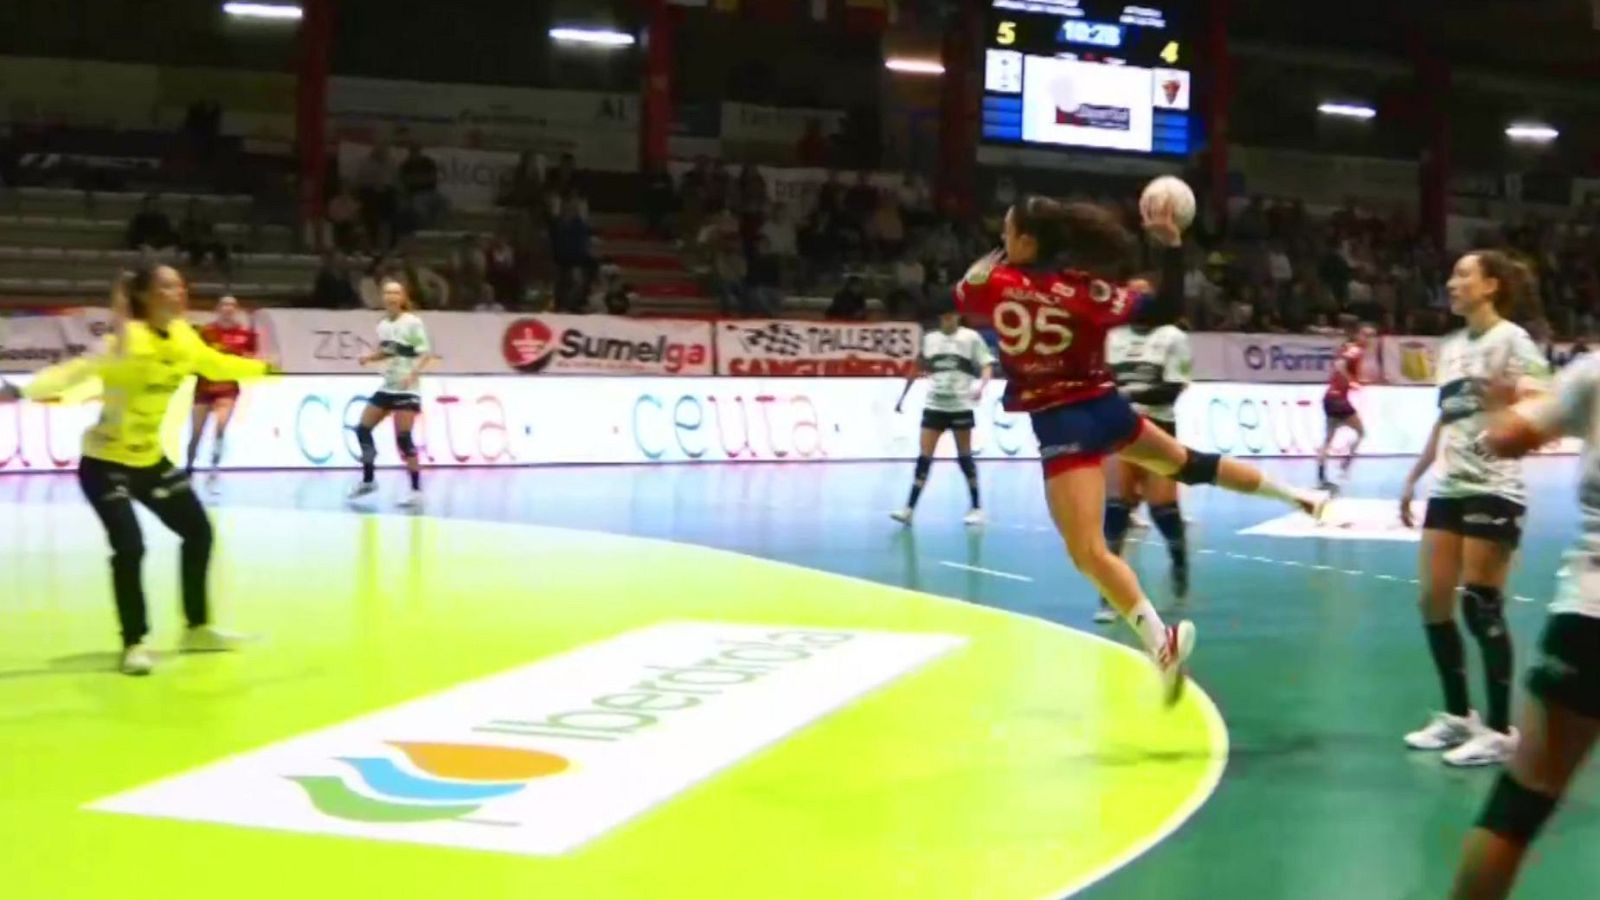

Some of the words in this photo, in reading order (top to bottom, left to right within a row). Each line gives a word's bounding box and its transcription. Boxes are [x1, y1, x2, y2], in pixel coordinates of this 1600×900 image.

[996, 21, 1017, 45] 5
[1159, 41, 1180, 63] 4
[559, 328, 706, 373] Sumelga
[807, 326, 913, 358] TALLERES
[993, 300, 1074, 356] 95
[632, 394, 828, 459] ceuta
[471, 629, 857, 742] Iberdrola
